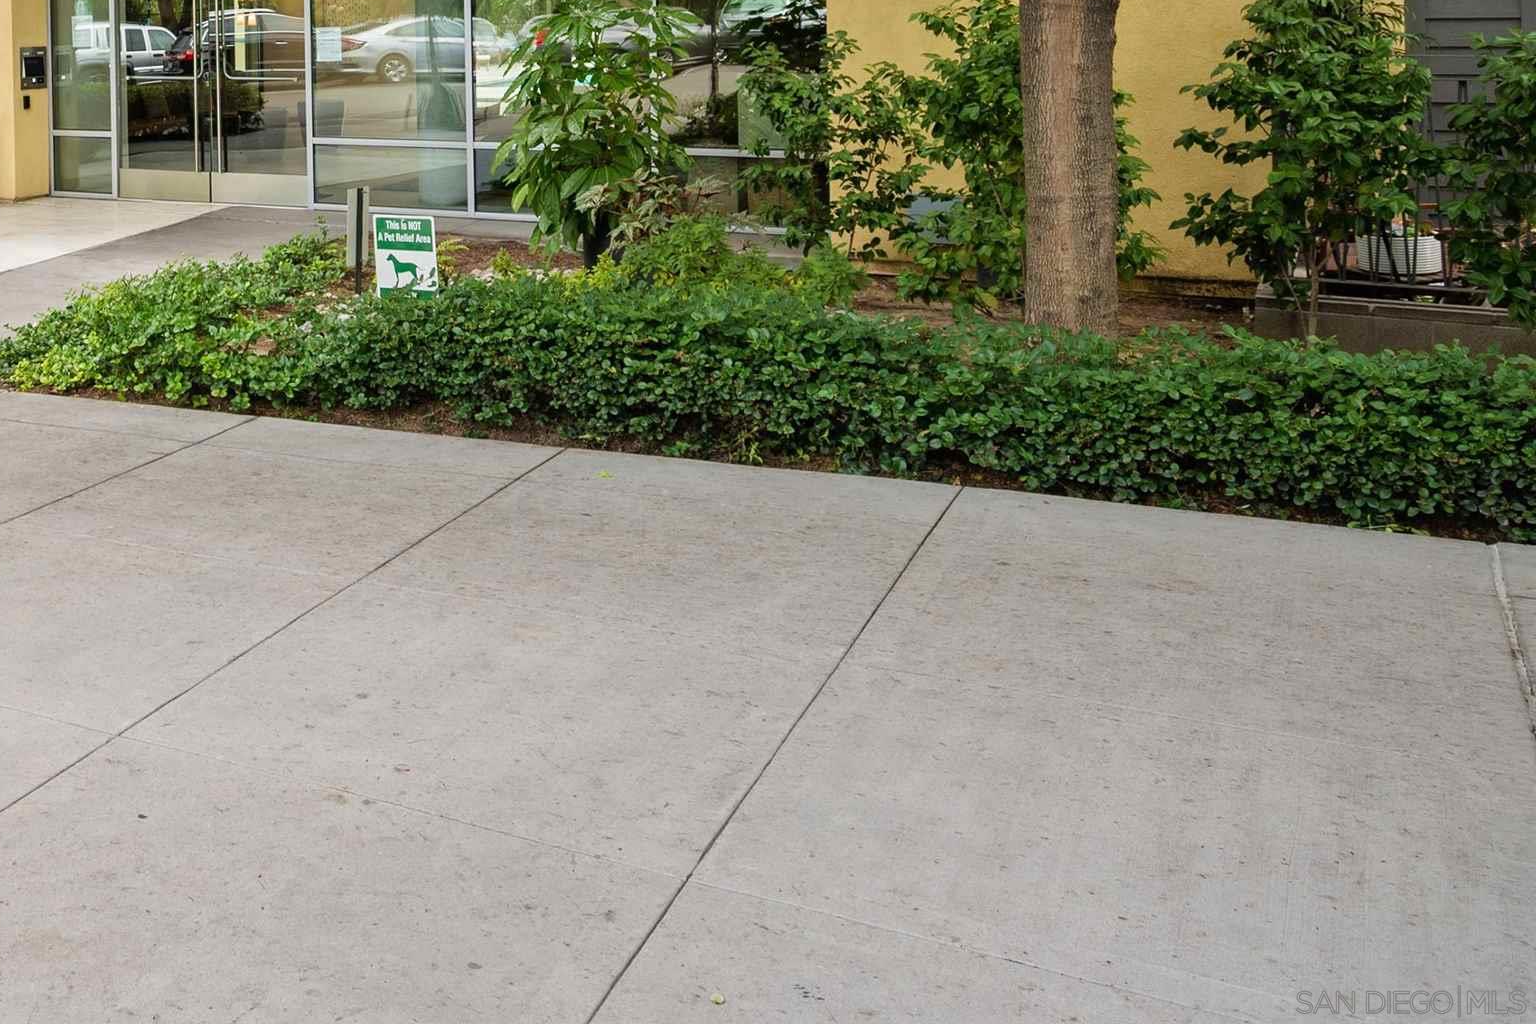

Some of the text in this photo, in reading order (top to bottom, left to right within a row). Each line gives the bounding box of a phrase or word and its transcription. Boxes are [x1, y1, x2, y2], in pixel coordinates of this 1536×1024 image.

[385, 219, 422, 231] This is NOT
[378, 231, 383, 241] A
[384, 232, 395, 242] Pet
[416, 233, 431, 244] Area
